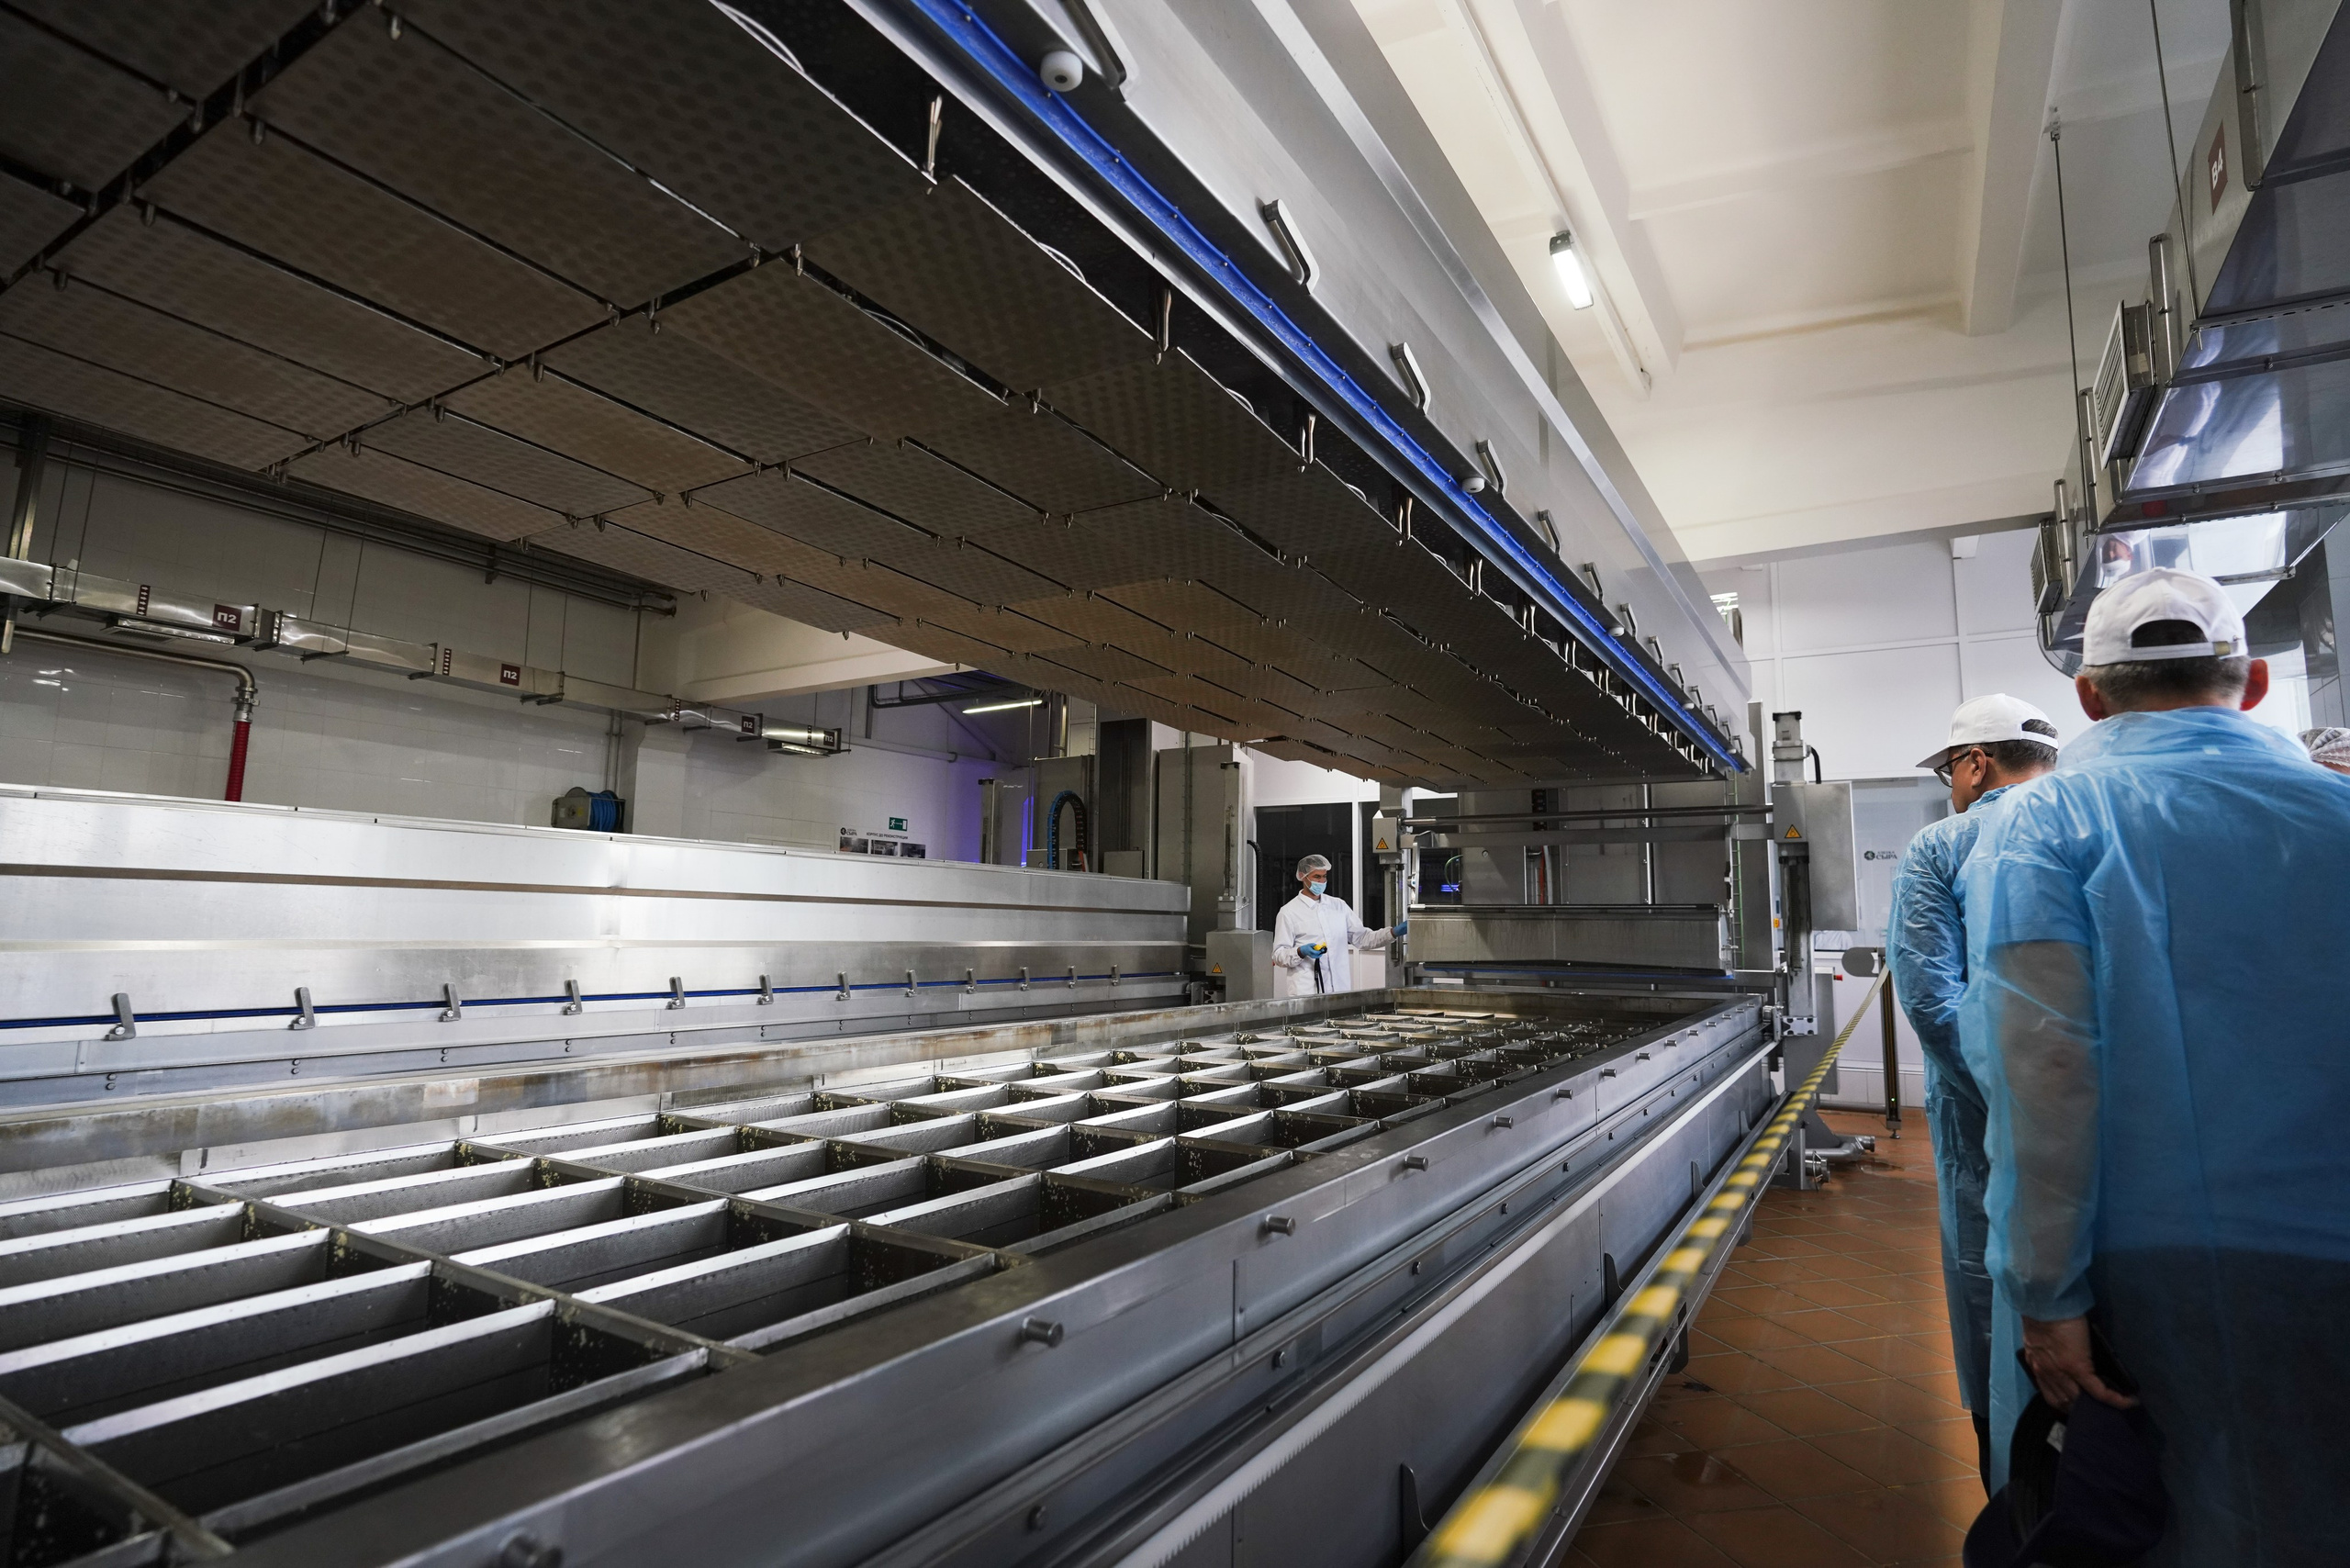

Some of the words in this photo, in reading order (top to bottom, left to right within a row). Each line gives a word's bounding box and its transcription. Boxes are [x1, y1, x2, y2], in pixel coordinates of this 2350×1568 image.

[217, 611, 237, 624] П2
[503, 669, 518, 680] П2
[743, 721, 753, 729] П2
